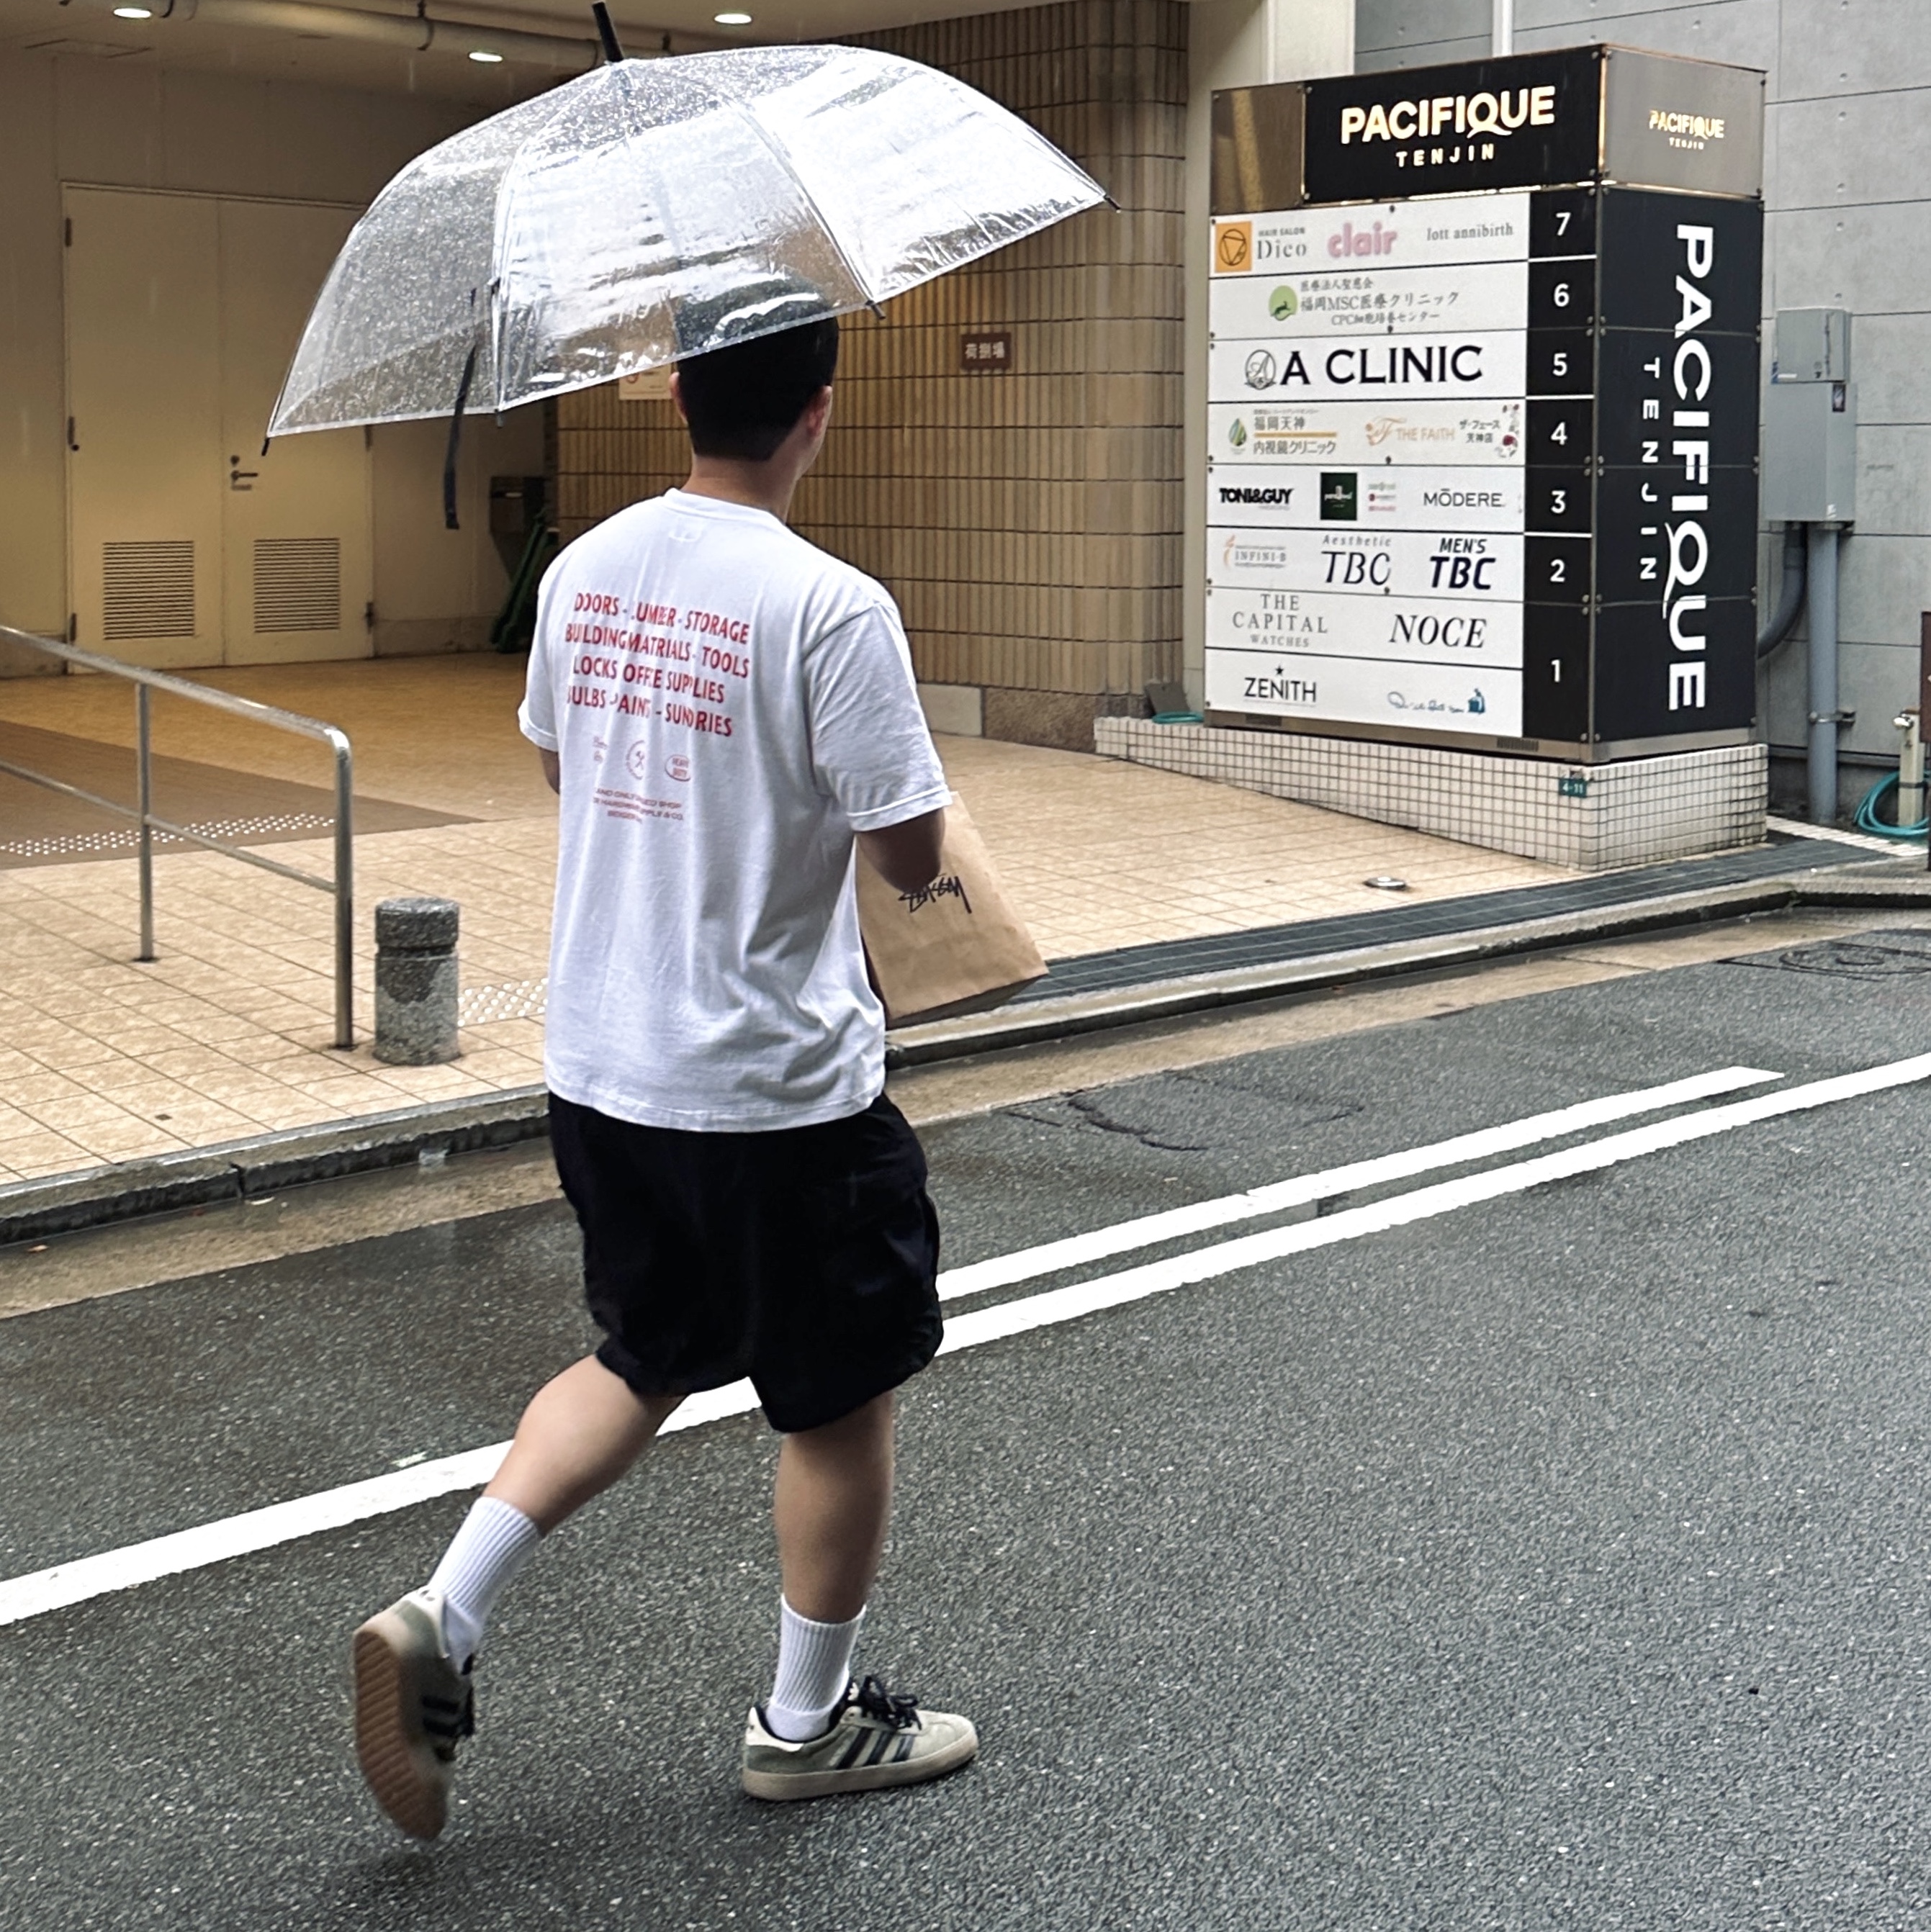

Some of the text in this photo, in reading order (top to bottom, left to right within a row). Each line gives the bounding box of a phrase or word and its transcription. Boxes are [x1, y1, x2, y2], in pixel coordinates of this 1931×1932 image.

[1341, 86, 1555, 143] PACIFIQUE
[1649, 109, 1725, 140] PACIFIQUE
[1395, 143, 1494, 168] TENJIN
[1280, 227, 1305, 236] SALON
[1556, 212, 1571, 236] 7
[1257, 239, 1307, 259] Dico
[1328, 221, 1397, 258] clair
[1554, 283, 1570, 307] 6
[1280, 345, 1482, 386] A CLINIC
[1553, 353, 1567, 376] 5
[1253, 416, 1305, 430] 福岡天神
[1551, 422, 1567, 445] 4
[1253, 440, 1337, 456] 内視鏡クリニック
[1640, 357, 1661, 579] TENJIN
[1662, 224, 1714, 710] PACIFIQUE
[1220, 487, 1294, 504] TONI&GUY
[1551, 490, 1565, 514] 3
[1323, 534, 1392, 547] Aesthetic
[1439, 537, 1487, 554] MEN'S
[1320, 551, 1391, 586] TBC
[1430, 556, 1496, 590] TBC
[1550, 559, 1565, 582] 2
[1261, 593, 1300, 611] THE
[685, 610, 750, 645] STORAGE
[1232, 611, 1328, 633] CAPITAL
[1389, 614, 1487, 649] NOCE
[1250, 633, 1310, 648] WATCHES
[702, 646, 750, 678] TOOLS
[1551, 659, 1560, 682] 1
[1243, 677, 1317, 702] ZENITH
